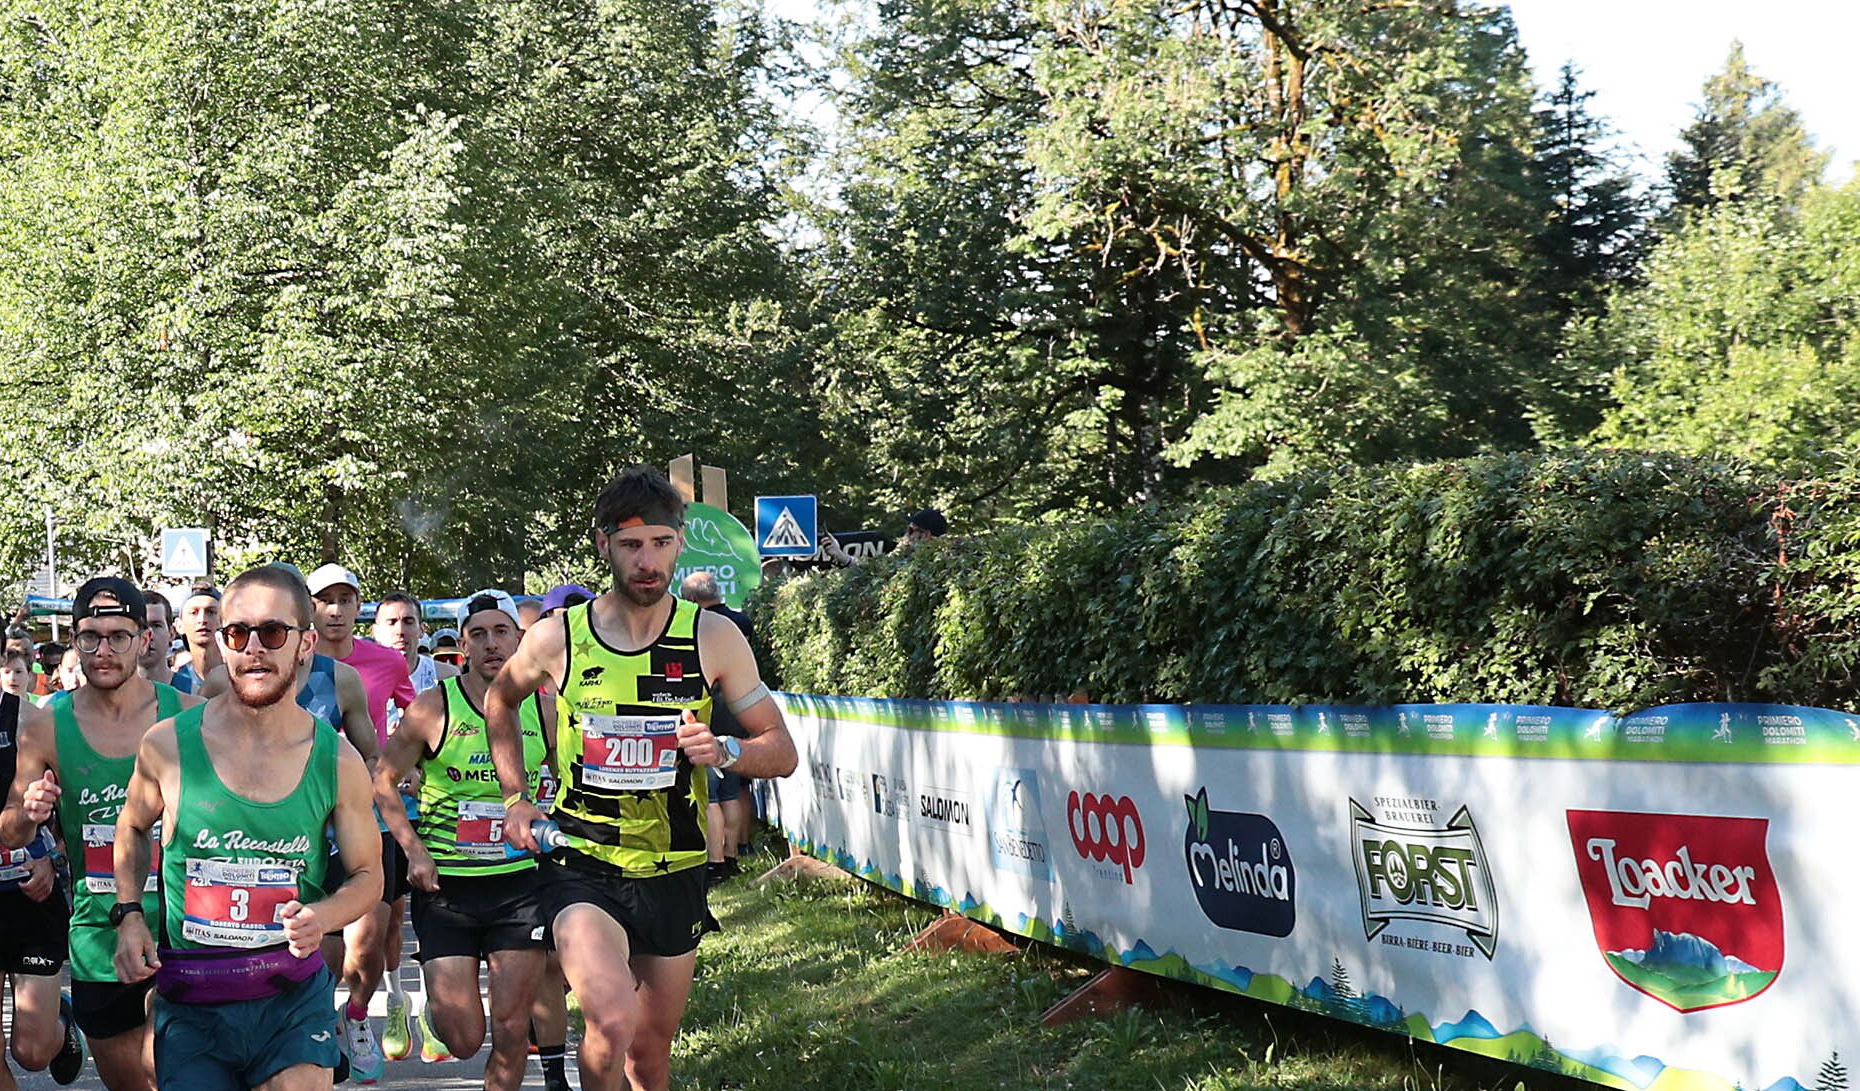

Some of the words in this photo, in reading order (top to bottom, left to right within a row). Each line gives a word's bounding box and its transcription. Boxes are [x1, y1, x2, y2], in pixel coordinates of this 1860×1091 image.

[1757, 715, 1802, 725] PRIMIERO
[1762, 726, 1805, 736] DOLOMITI
[605, 738, 653, 766] 200
[78, 788, 100, 805] La
[920, 794, 970, 826] SALOMON
[1385, 811, 1435, 825] BRAUEREI
[193, 828, 220, 849] La
[1067, 790, 1146, 885] coop
[191, 878, 213, 887] 42K
[1362, 839, 1478, 911] FORST
[1587, 837, 1757, 911] Loacker
[229, 888, 249, 921] 3
[213, 933, 254, 941] SALOMON
